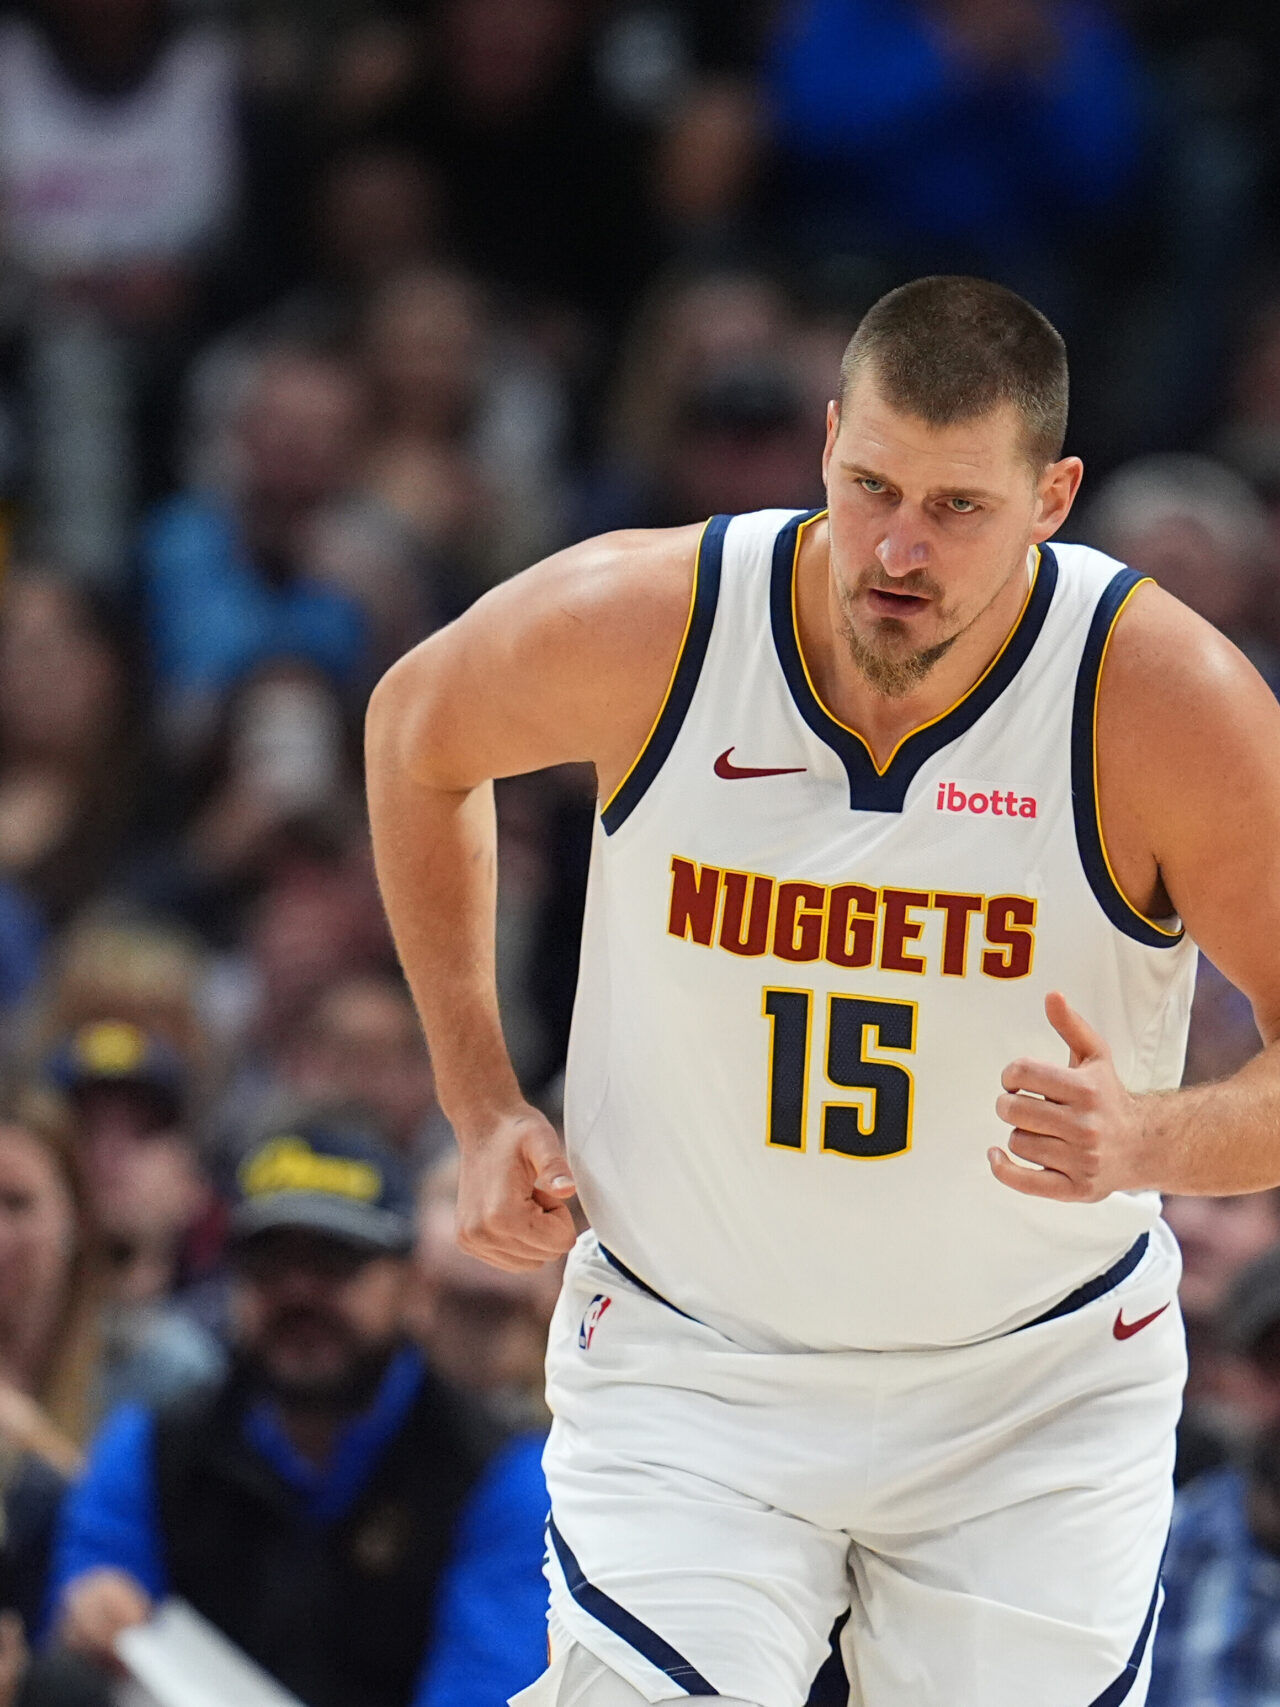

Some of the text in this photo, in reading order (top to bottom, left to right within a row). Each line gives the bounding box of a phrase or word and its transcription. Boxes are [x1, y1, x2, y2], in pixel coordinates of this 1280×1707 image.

[936, 782, 1037, 818] ibotta
[666, 854, 1038, 979] NUGGETS
[761, 985, 918, 1161] 15
